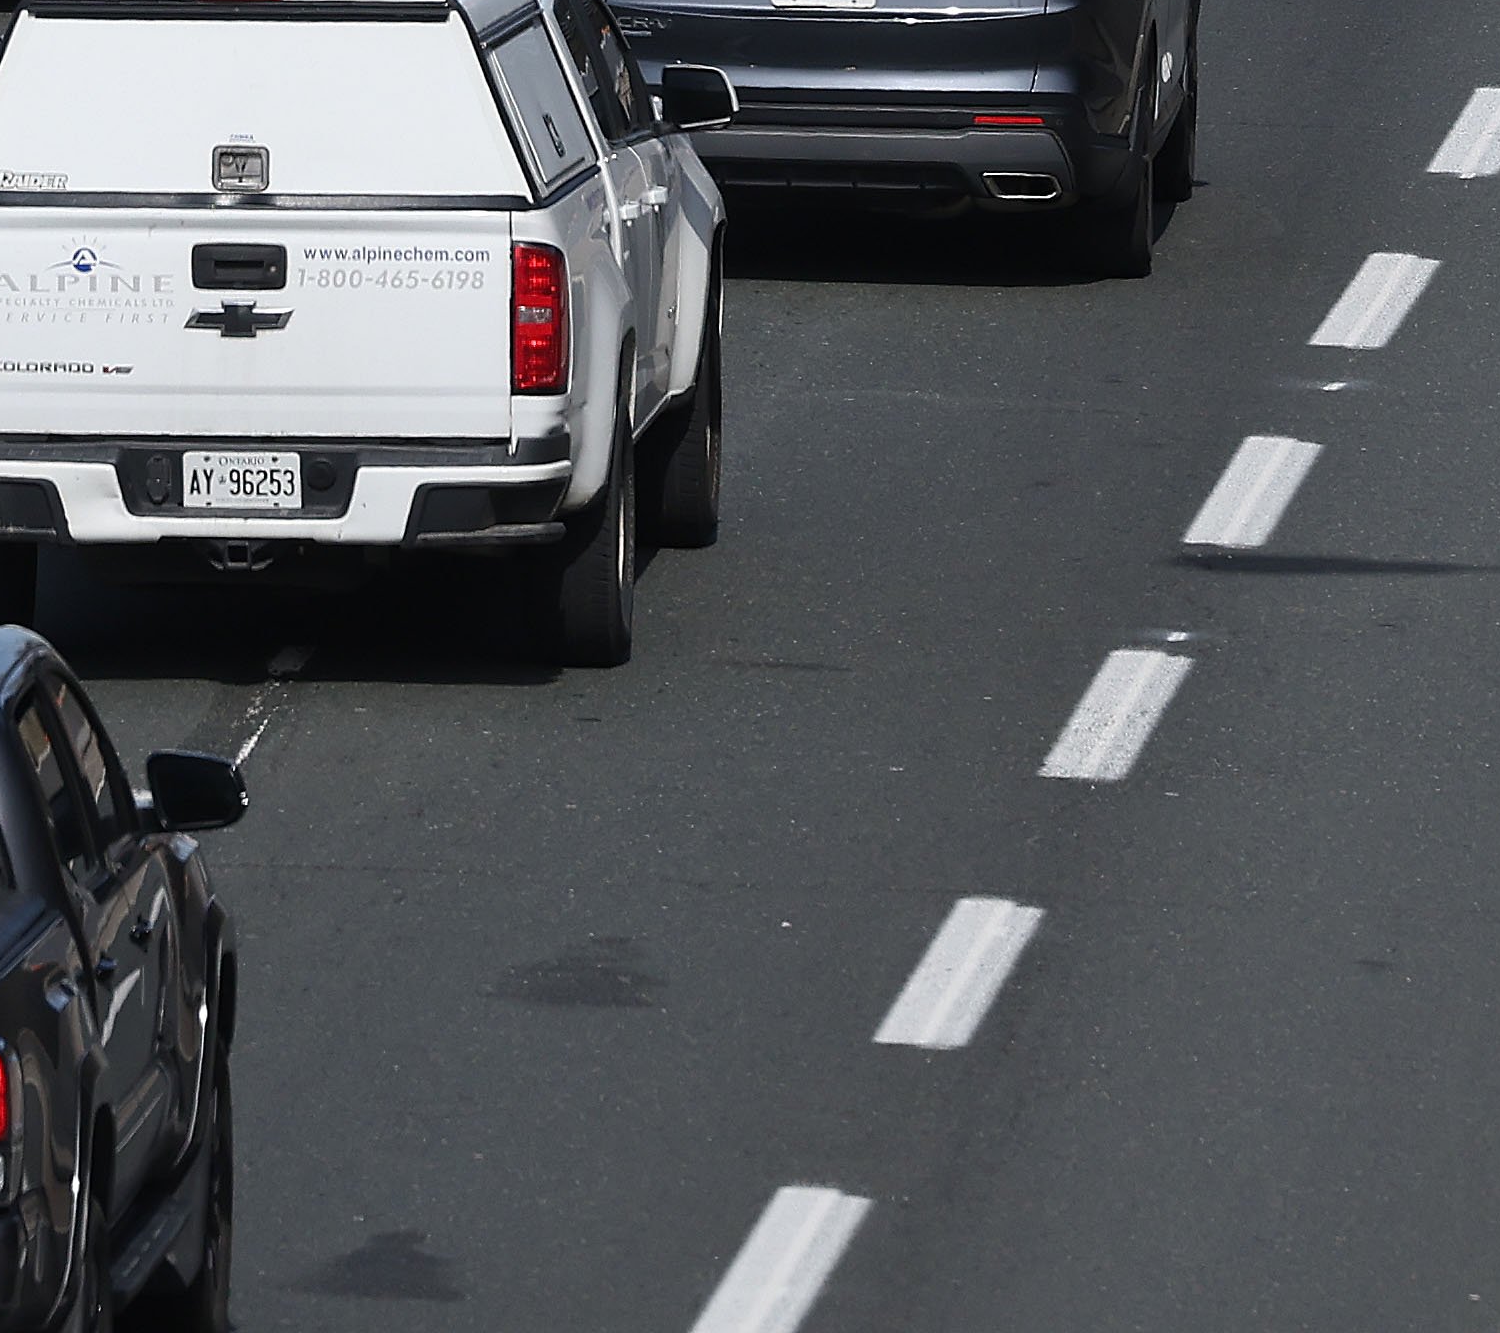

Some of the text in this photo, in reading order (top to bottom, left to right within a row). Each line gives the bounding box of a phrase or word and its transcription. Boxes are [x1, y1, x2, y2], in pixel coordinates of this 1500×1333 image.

[303, 245, 491, 265] www.alpinechem.com
[298, 267, 486, 290] 1-800-465-6198
[68, 296, 149, 309] CHEMICALS
[105, 313, 170, 325] FIRST
[218, 455, 265, 467] ONTARIO
[189, 468, 296, 496] AY 96253
